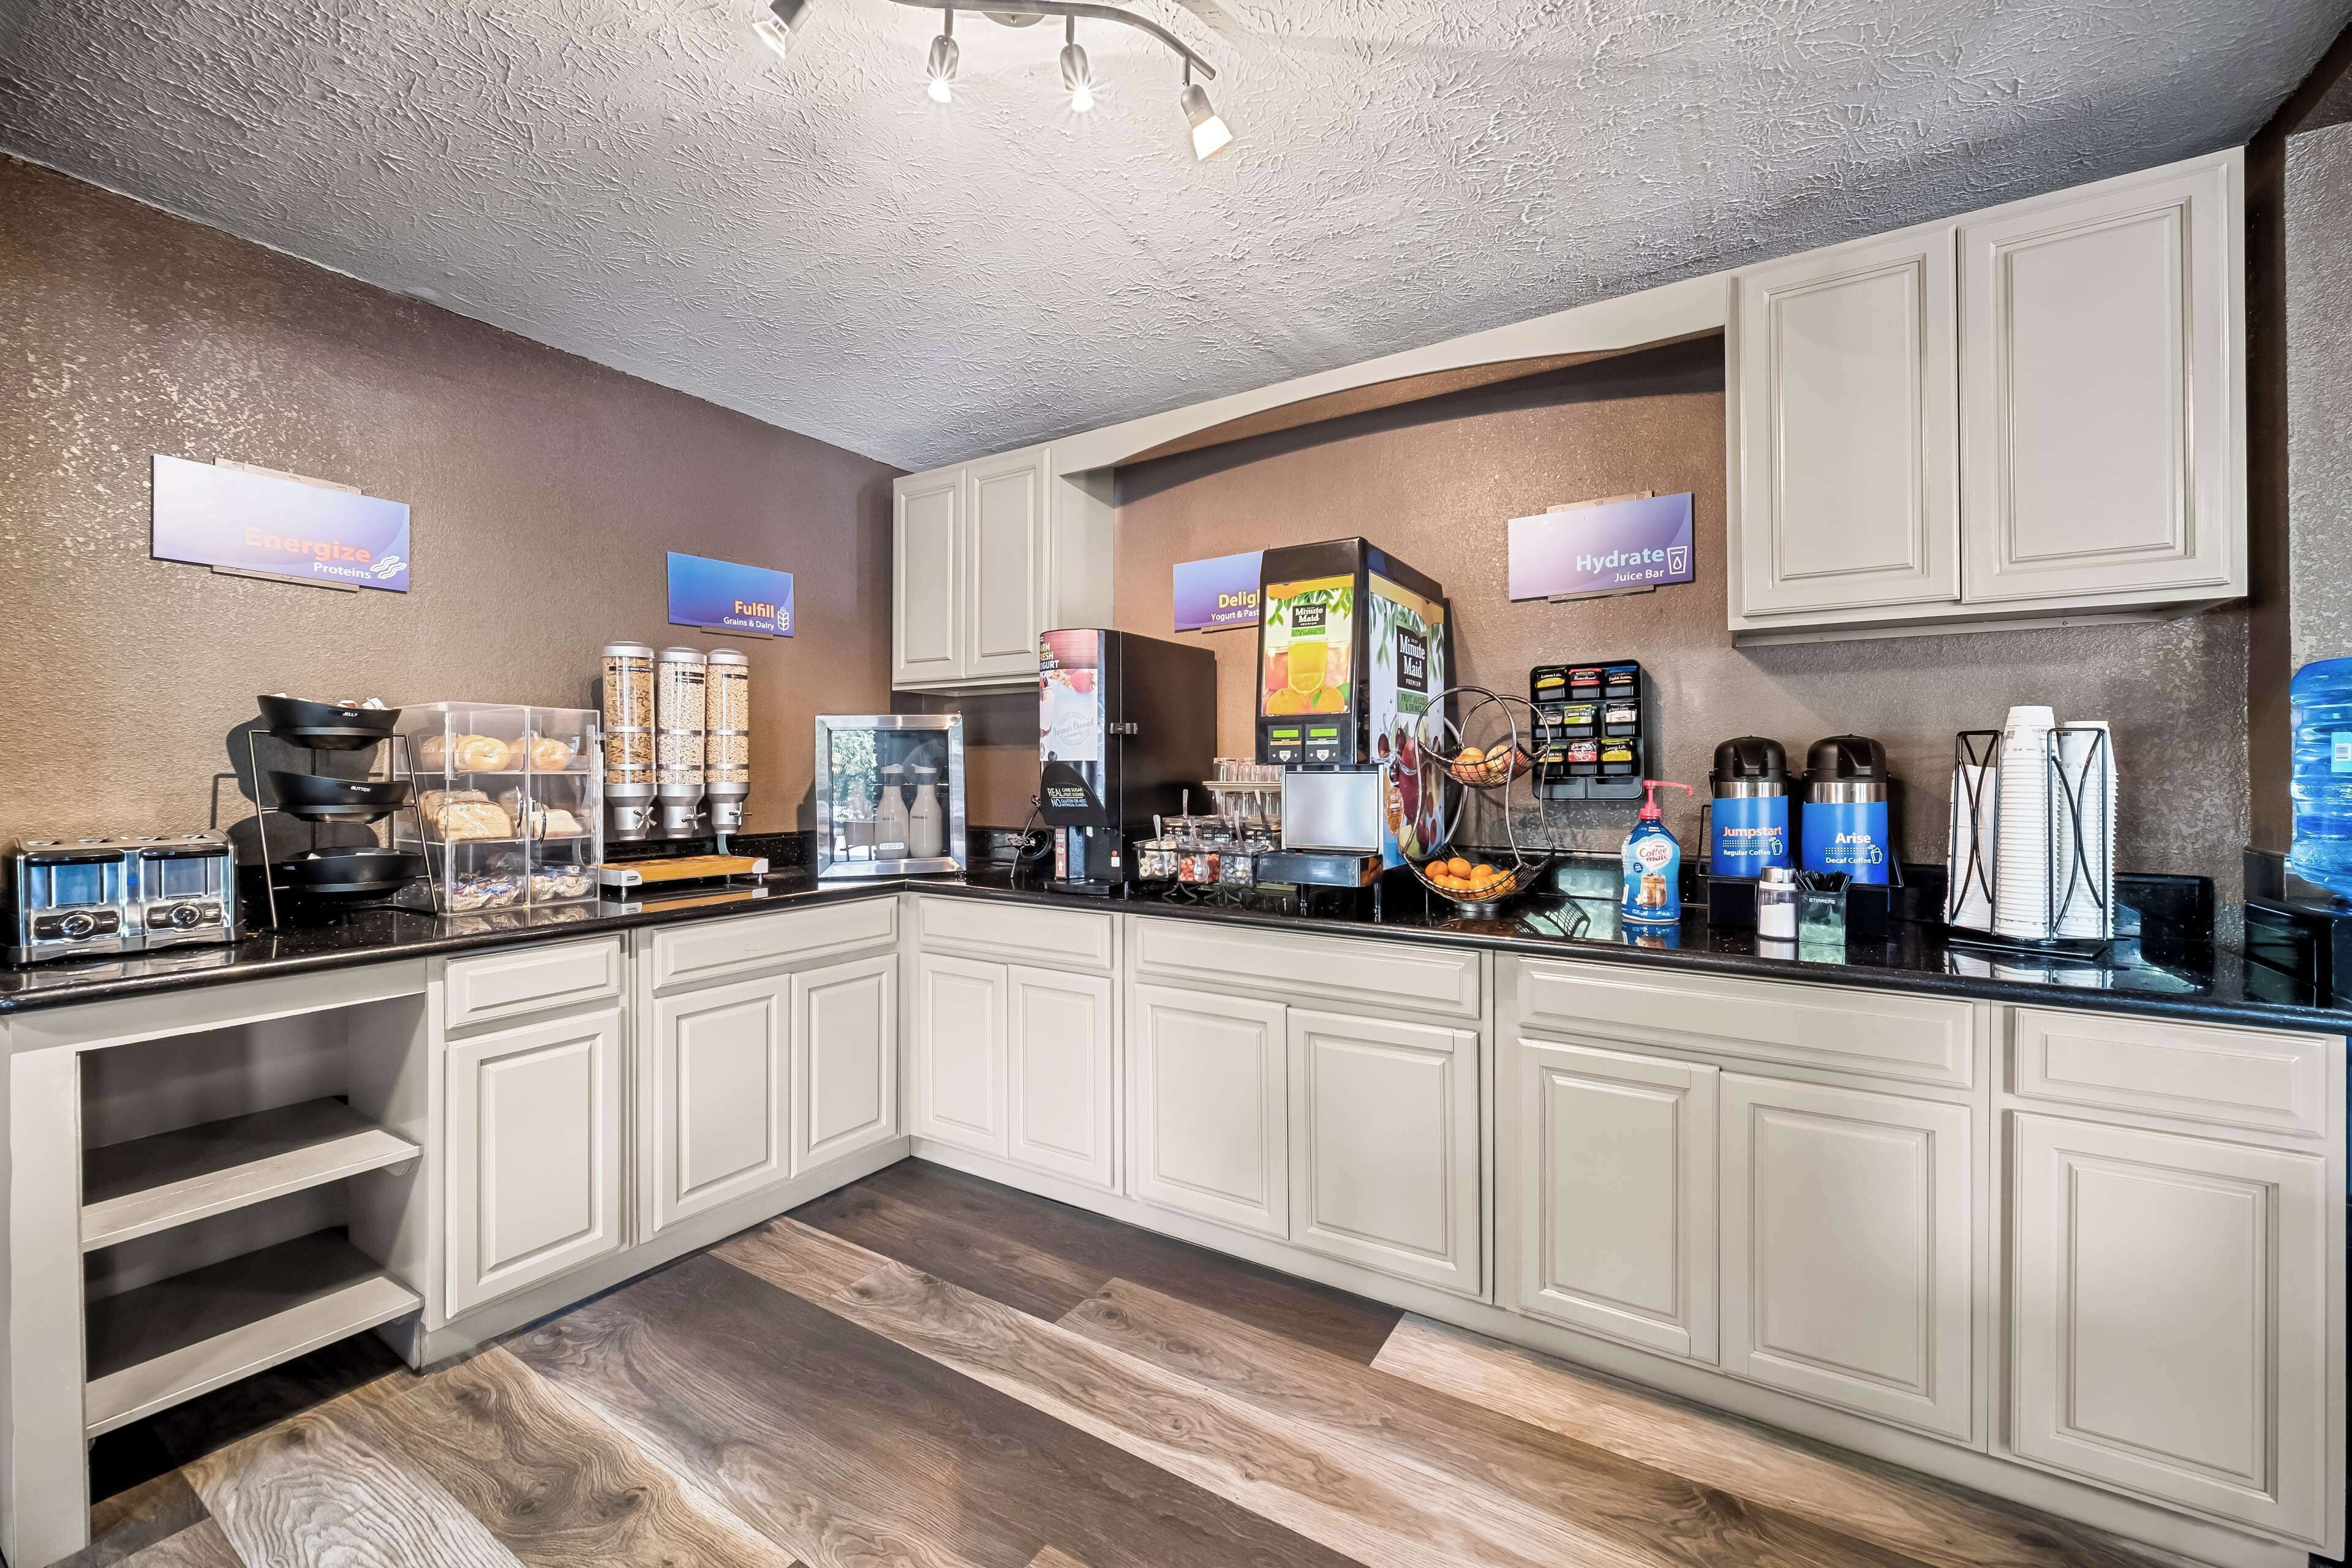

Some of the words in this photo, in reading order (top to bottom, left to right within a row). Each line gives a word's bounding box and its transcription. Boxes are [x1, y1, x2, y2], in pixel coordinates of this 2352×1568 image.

[244, 526, 372, 564] Energize
[1577, 548, 1665, 575] Hydrate
[313, 562, 371, 579] Proteins
[1614, 571, 1643, 582] Juice
[1645, 569, 1665, 579] Bar
[734, 600, 775, 619] Fulfill
[1211, 612, 1235, 622] Yogurt
[1244, 608, 1259, 617] Past
[1295, 606, 1324, 616] Minute
[723, 616, 748, 627] Grains
[748, 619, 755, 628] &
[755, 620, 775, 631] Dairy
[1298, 613, 1320, 623] Maid
[1399, 633, 1426, 660] Minute
[1040, 660, 1060, 670] OGURT
[1403, 655, 1423, 679] Maid
[1406, 678, 1421, 687] PREMIUM
[1401, 693, 1412, 703] FRUIT
[1047, 788, 1064, 797] REAL
[1050, 798, 1061, 807] NO
[1723, 826, 1782, 839] Jumpstart
[1834, 832, 1871, 844] Arise
[1639, 848, 1667, 858] Coffee
